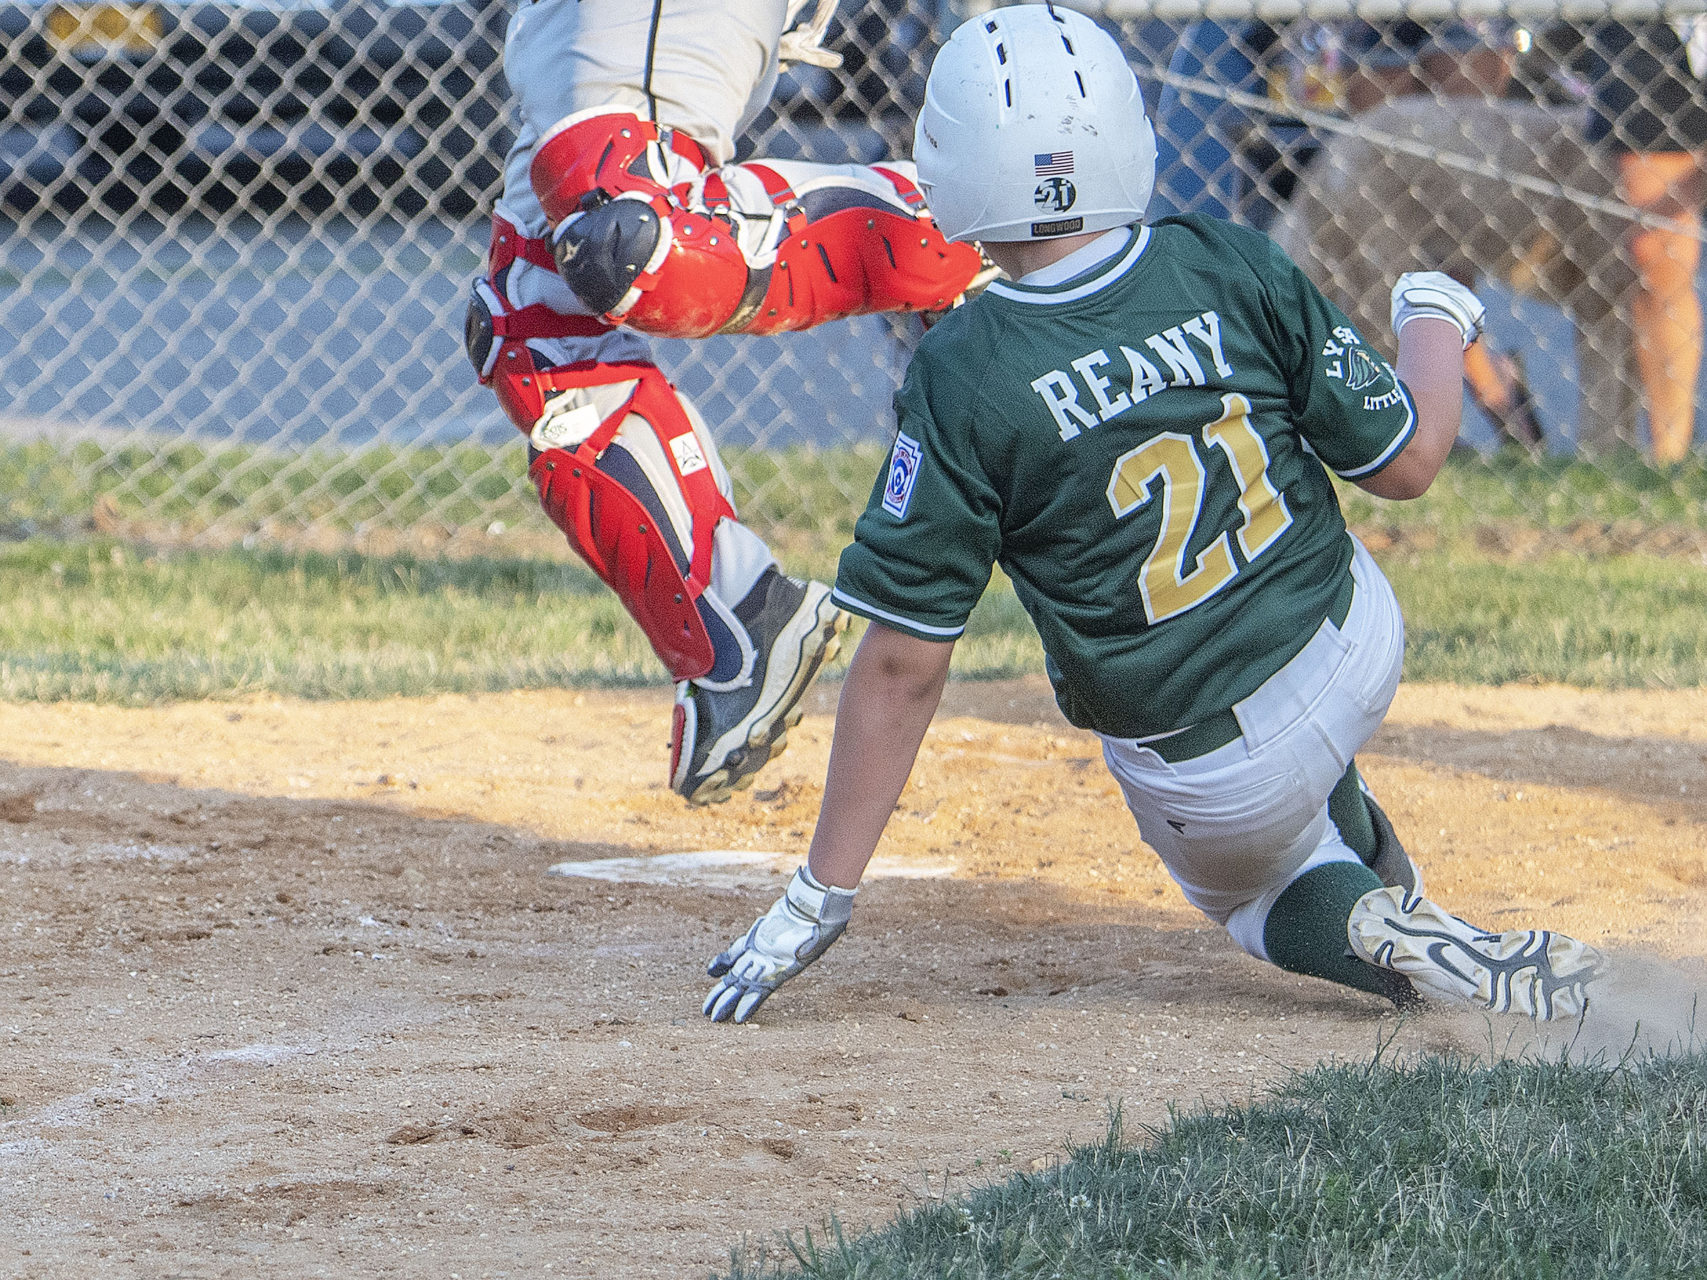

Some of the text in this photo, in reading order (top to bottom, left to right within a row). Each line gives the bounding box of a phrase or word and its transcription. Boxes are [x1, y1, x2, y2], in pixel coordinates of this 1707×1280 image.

[1033, 220, 1081, 234] LONGWOOD
[1039, 179, 1072, 210] 21
[1031, 311, 1233, 442] REANY
[1105, 392, 1294, 626] 21
